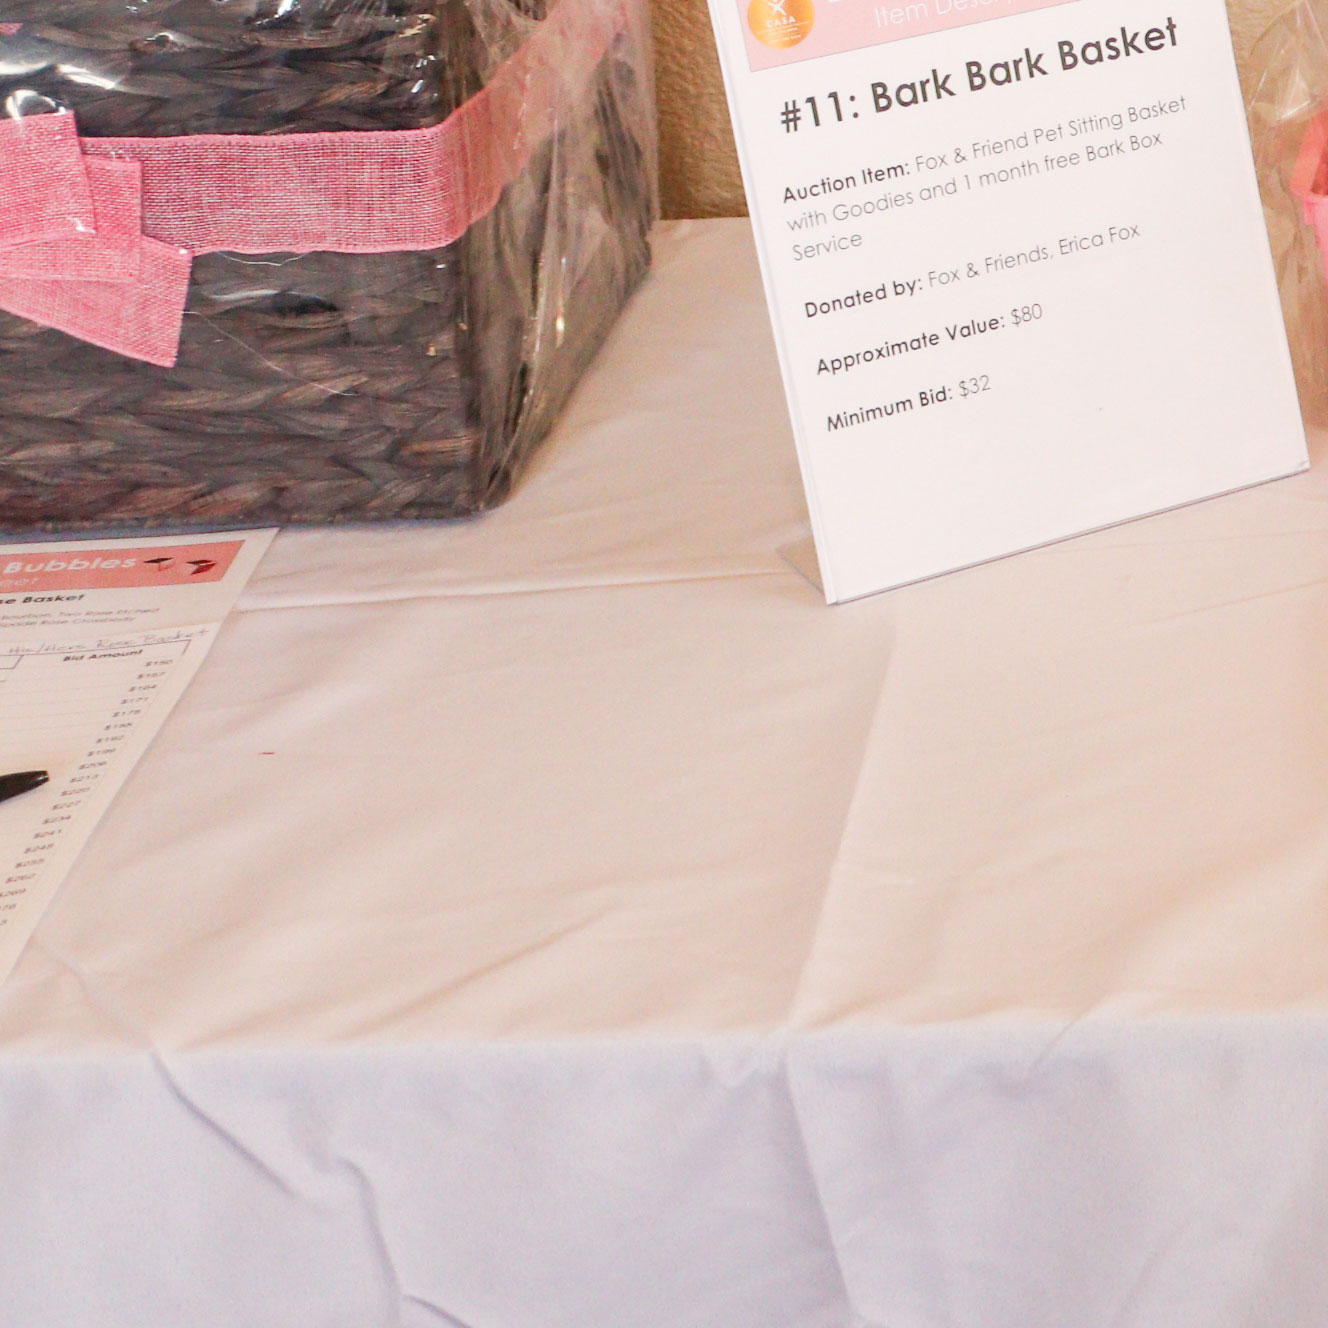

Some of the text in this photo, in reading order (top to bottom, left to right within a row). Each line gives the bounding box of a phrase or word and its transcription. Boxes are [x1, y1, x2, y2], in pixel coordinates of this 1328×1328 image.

[766, 15, 796, 28] CASA
[781, 17, 1179, 133] #11: Bark Bark Basket
[783, 95, 1187, 203] Auction Item: Fox & Friend Pet Sitting Basket
[787, 131, 1163, 231] with Goodies and 1 month free Bark Box
[793, 232, 863, 261] Service
[805, 223, 1141, 318] Donated by: Fox & Friends, Erica Fox
[817, 304, 1043, 376] Approximate Value: $80
[827, 375, 992, 432] Minimum Bid: $32
[5, 557, 137, 573] Bubbles
[22, 593, 86, 604] Basket
[89, 649, 144, 660] Amount
